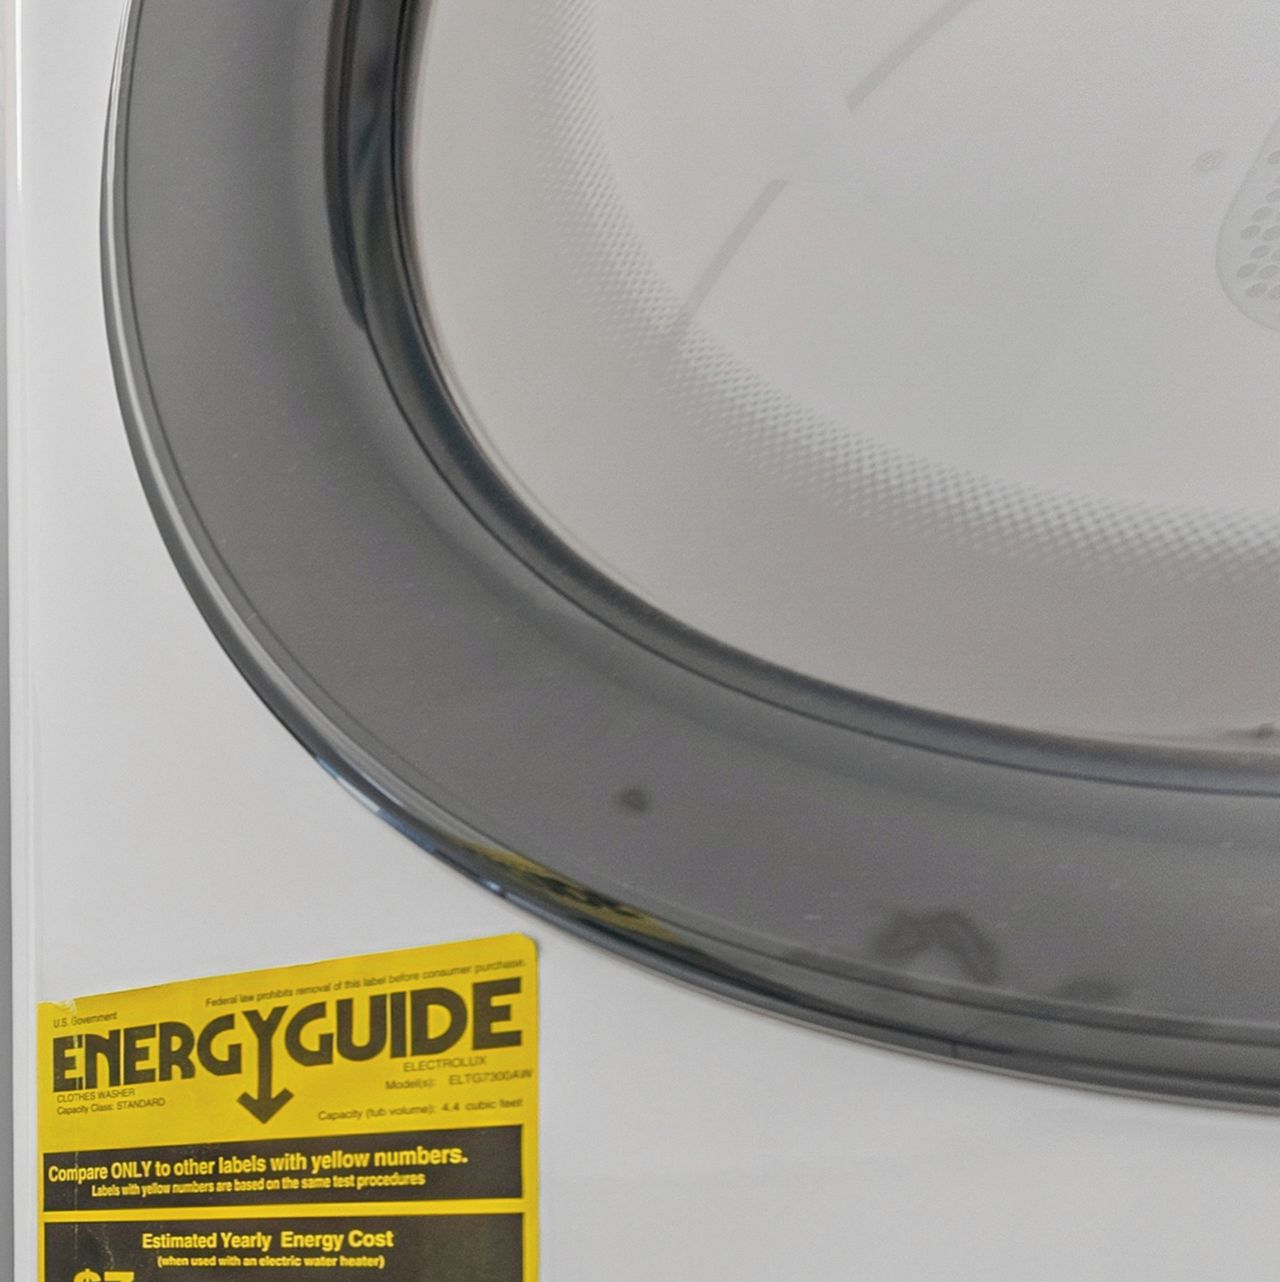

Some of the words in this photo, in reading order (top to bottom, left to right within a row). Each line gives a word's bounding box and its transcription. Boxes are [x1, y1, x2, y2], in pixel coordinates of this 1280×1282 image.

[205, 994, 237, 1007] Federal
[240, 992, 254, 1003] law
[257, 989, 293, 1003] prohibits
[296, 983, 331, 996] removal
[334, 981, 342, 991] of
[344, 979, 361, 990] this
[363, 976, 386, 987] label
[388, 973, 420, 984] before
[423, 966, 472, 980] consumer
[53, 1017, 69, 1028] U.S.
[71, 1012, 118, 1026] Government
[52, 976, 522, 1096] ENERGYGUIDE
[403, 1056, 486, 1072] ELECTROLUX
[385, 1078, 436, 1090] Model(s):
[57, 1093, 95, 1104] CLOTHES
[97, 1088, 135, 1100] WASHER
[57, 1104, 89, 1116] Capacity
[91, 1102, 114, 1112] Class:
[117, 1098, 166, 1111] STANDARD
[318, 1109, 362, 1122] Capacity
[366, 1106, 385, 1119] (tub
[389, 1104, 435, 1116] volume):
[442, 1102, 460, 1112] 4.4
[465, 1100, 497, 1112] cubic
[499, 1098, 523, 1108] feet
[48, 1165, 108, 1185] Compare
[111, 1160, 153, 1179] ONLY
[154, 1160, 171, 1177] to
[174, 1159, 216, 1176] other
[218, 1154, 267, 1174] labels
[270, 1152, 308, 1171] with
[311, 1150, 370, 1174] yellow
[374, 1146, 468, 1167] numbers.
[91, 1184, 120, 1198] Labels
[122, 1182, 140, 1196] with
[142, 1182, 171, 1198] yellow
[172, 1180, 214, 1194] numbers
[216, 1181, 232, 1192] are
[234, 1178, 264, 1192] based
[266, 1179, 280, 1190] on
[282, 1178, 299, 1190] the
[301, 1176, 331, 1189] same
[332, 1174, 355, 1188] test
[357, 1172, 426, 1190] procedures
[142, 1232, 217, 1250] Estimated
[220, 1231, 272, 1252] Yearly
[280, 1230, 344, 1252] Energy
[348, 1230, 394, 1248] Cost
[157, 1256, 189, 1268] (when
[190, 1256, 216, 1266] used
[218, 1256, 241, 1266] with
[242, 1256, 257, 1266] an
[259, 1256, 302, 1266] electric
[304, 1256, 337, 1267] water
[340, 1256, 386, 1269] heater)
